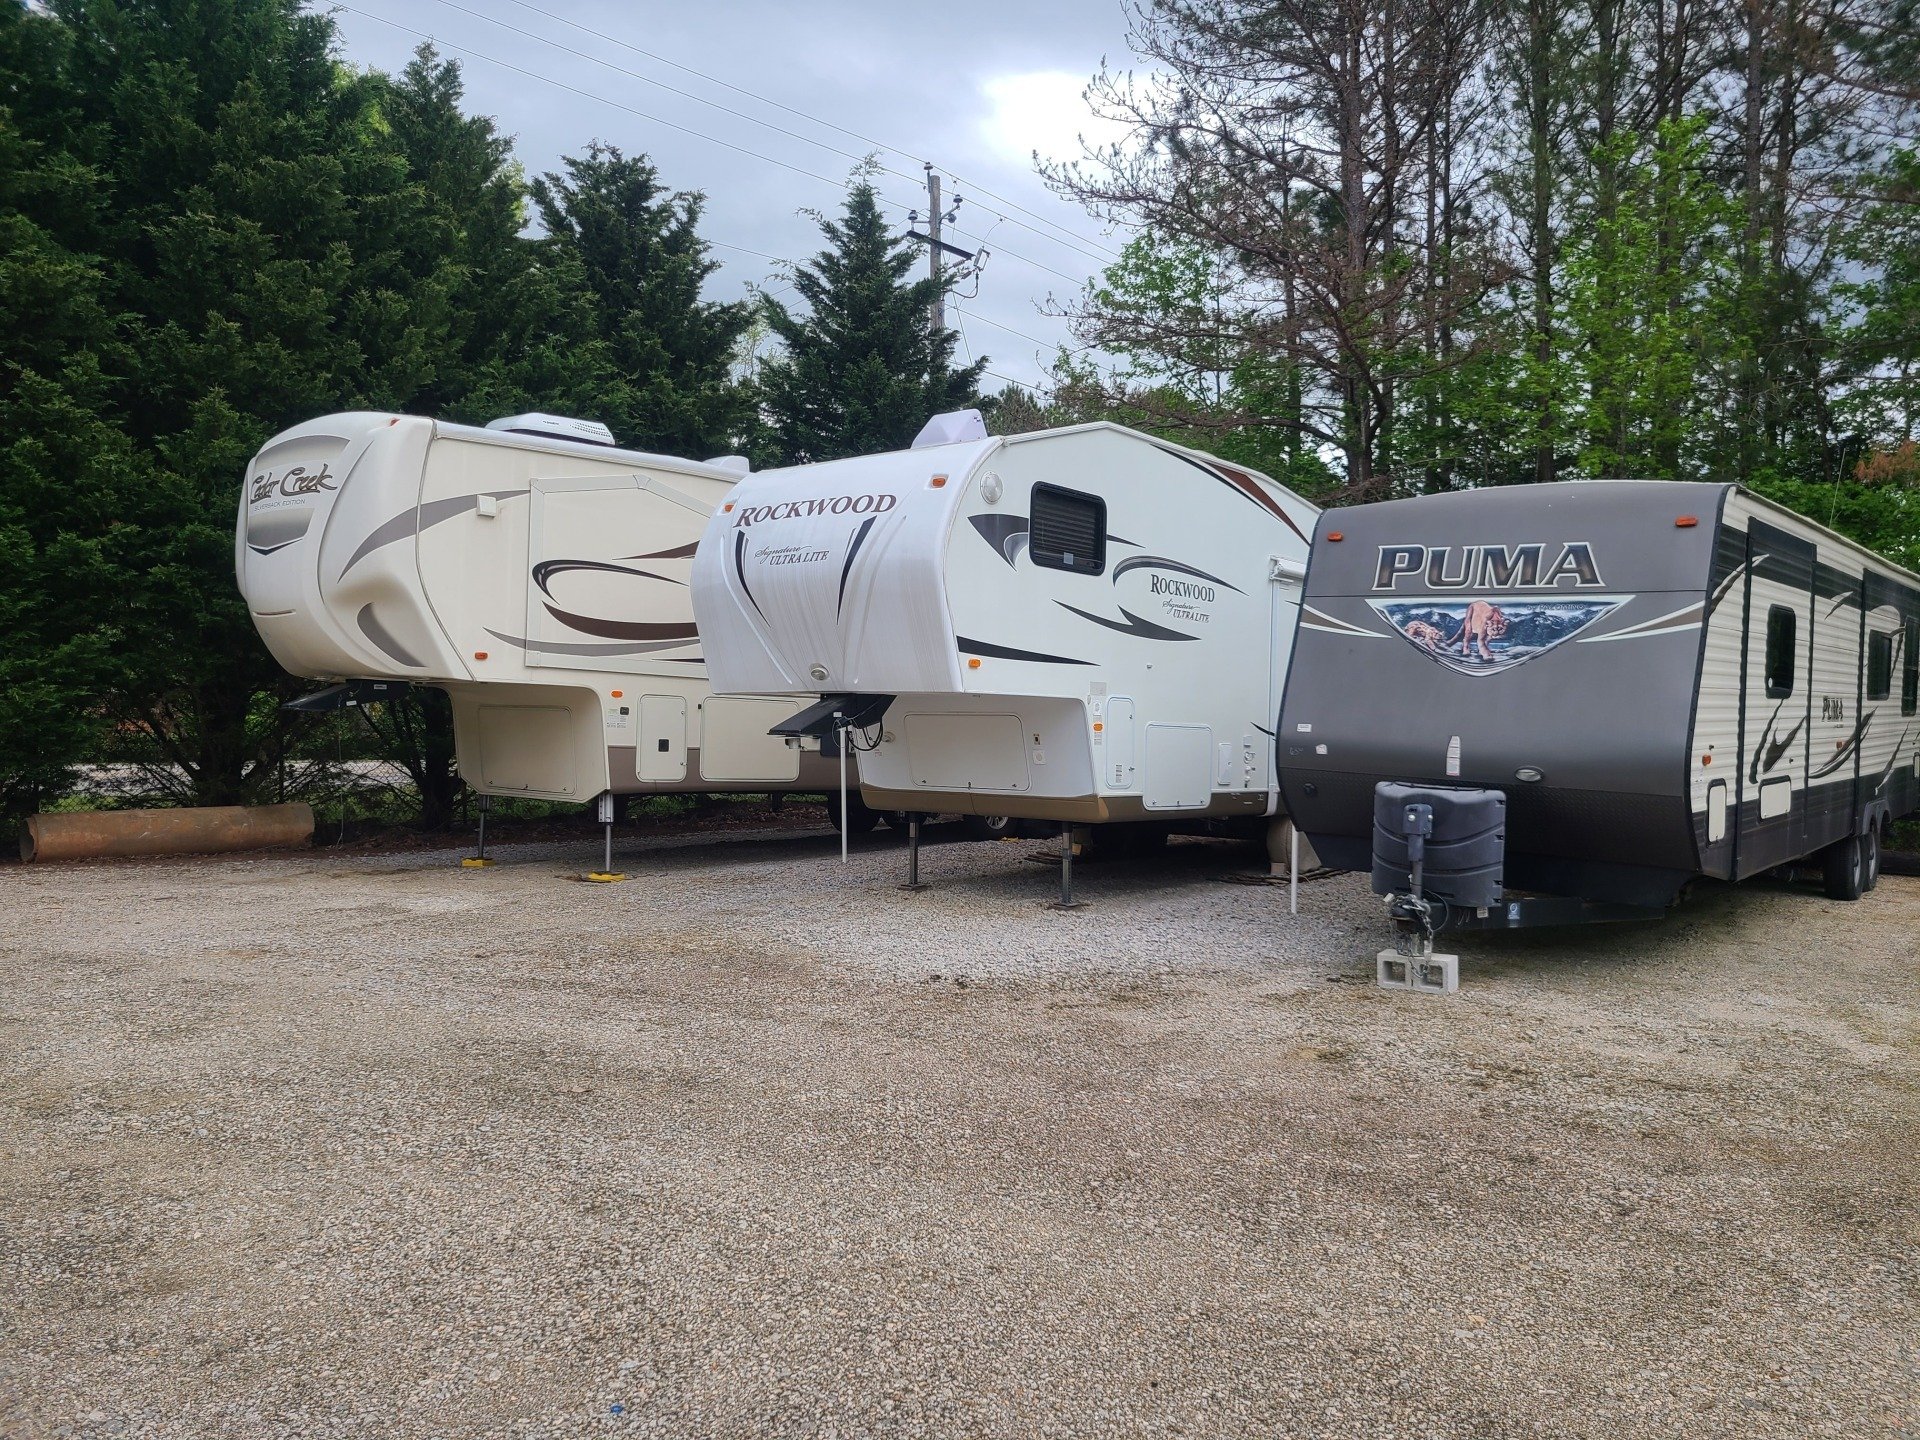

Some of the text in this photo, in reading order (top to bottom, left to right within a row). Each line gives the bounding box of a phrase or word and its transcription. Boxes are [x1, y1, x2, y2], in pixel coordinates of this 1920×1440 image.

[280, 463, 338, 497] Creek
[732, 494, 897, 528] ROCKWOOD
[754, 545, 812, 565] Signature
[769, 550, 830, 566] ULTRA LITE
[1371, 541, 1607, 591] PUMA
[1150, 573, 1215, 602] ROCKWOOD
[1162, 598, 1201, 614] Signature
